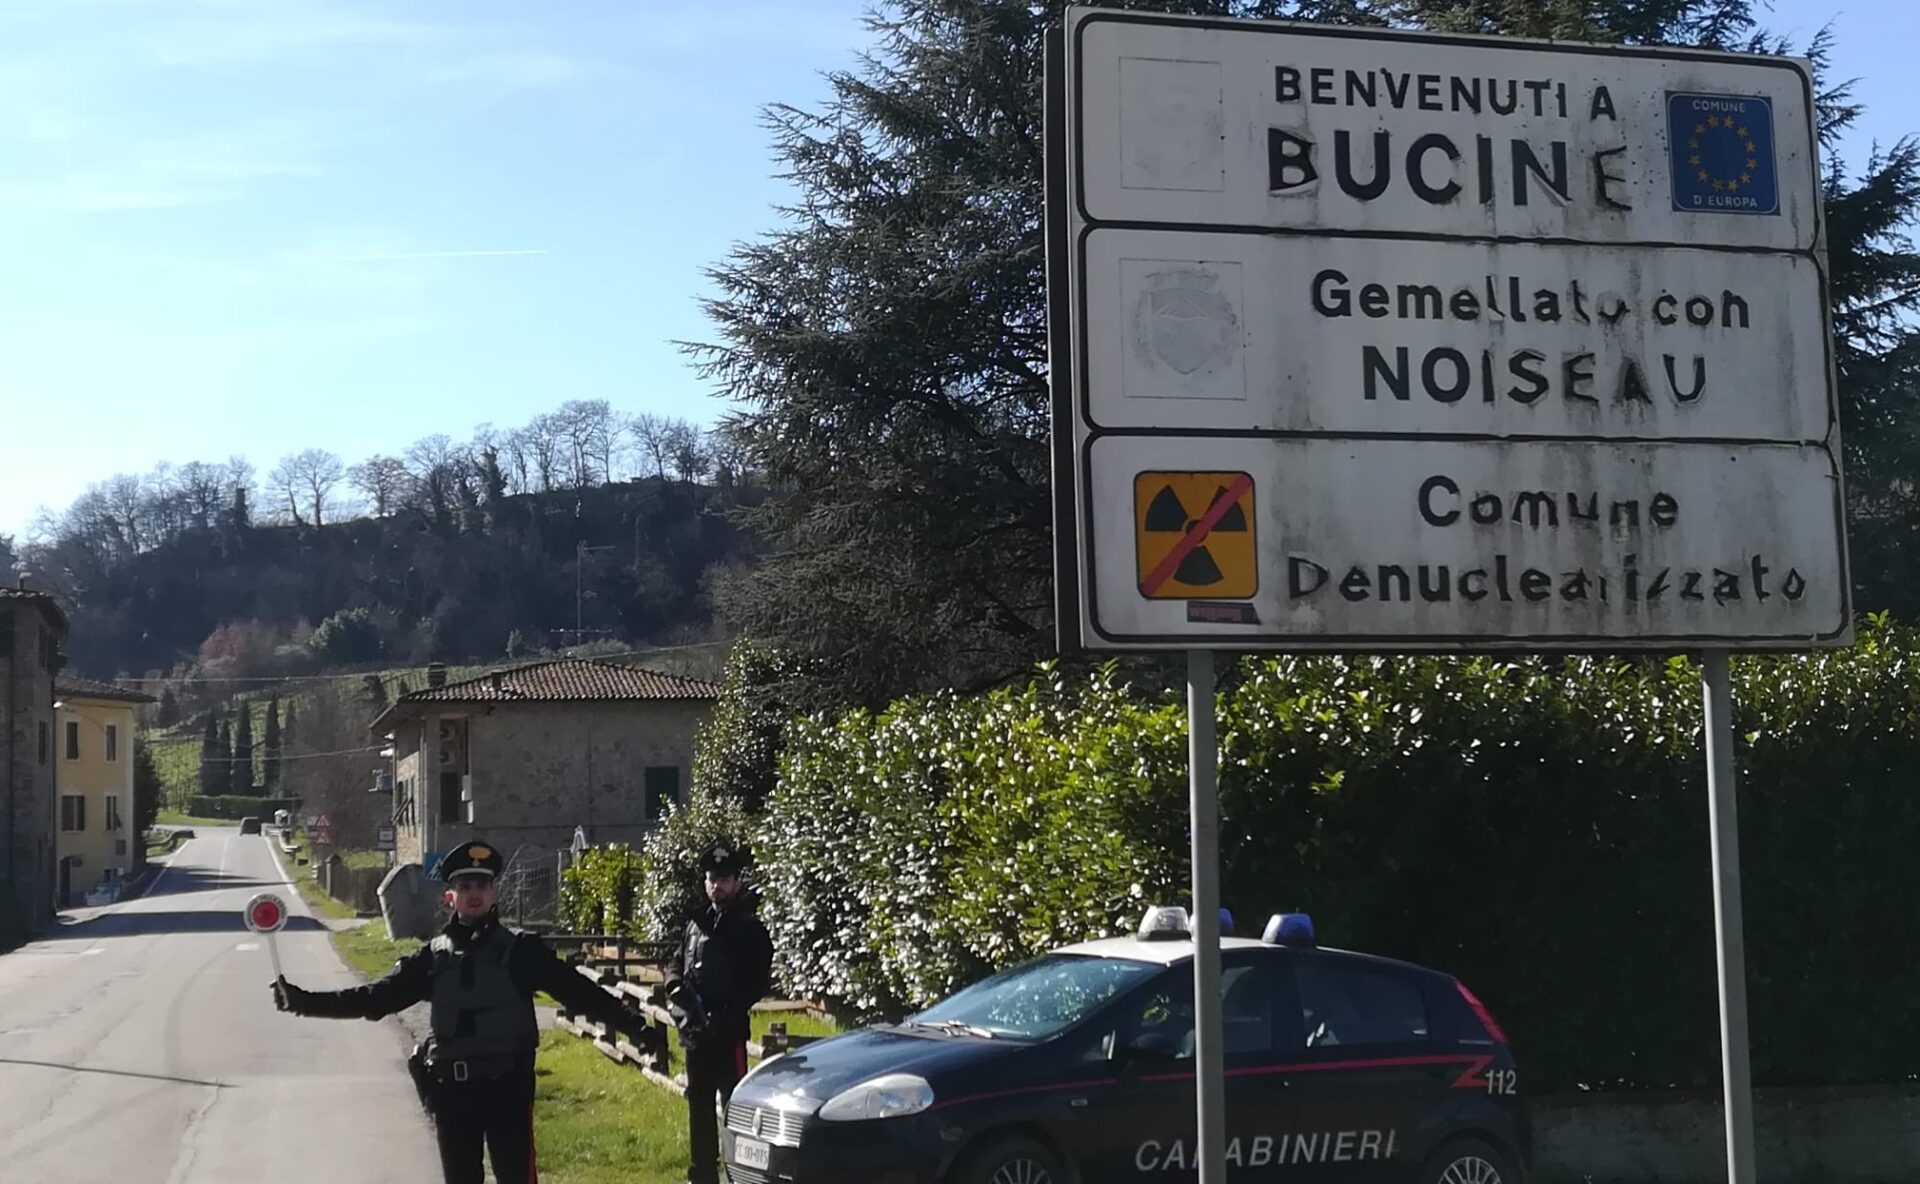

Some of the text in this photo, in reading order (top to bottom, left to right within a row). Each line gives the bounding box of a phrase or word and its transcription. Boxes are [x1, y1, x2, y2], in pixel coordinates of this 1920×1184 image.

[1275, 65, 1617, 121] BENVENUTI A
[1692, 99, 1746, 113] COMUNE
[1268, 127, 1632, 212] BUCINE
[1708, 195, 1758, 208] EUROPA
[1653, 289, 1750, 329] con
[1362, 346, 1707, 407] NOISEAU
[1418, 475, 1679, 528] Comune
[1485, 1070, 1517, 1095] 112
